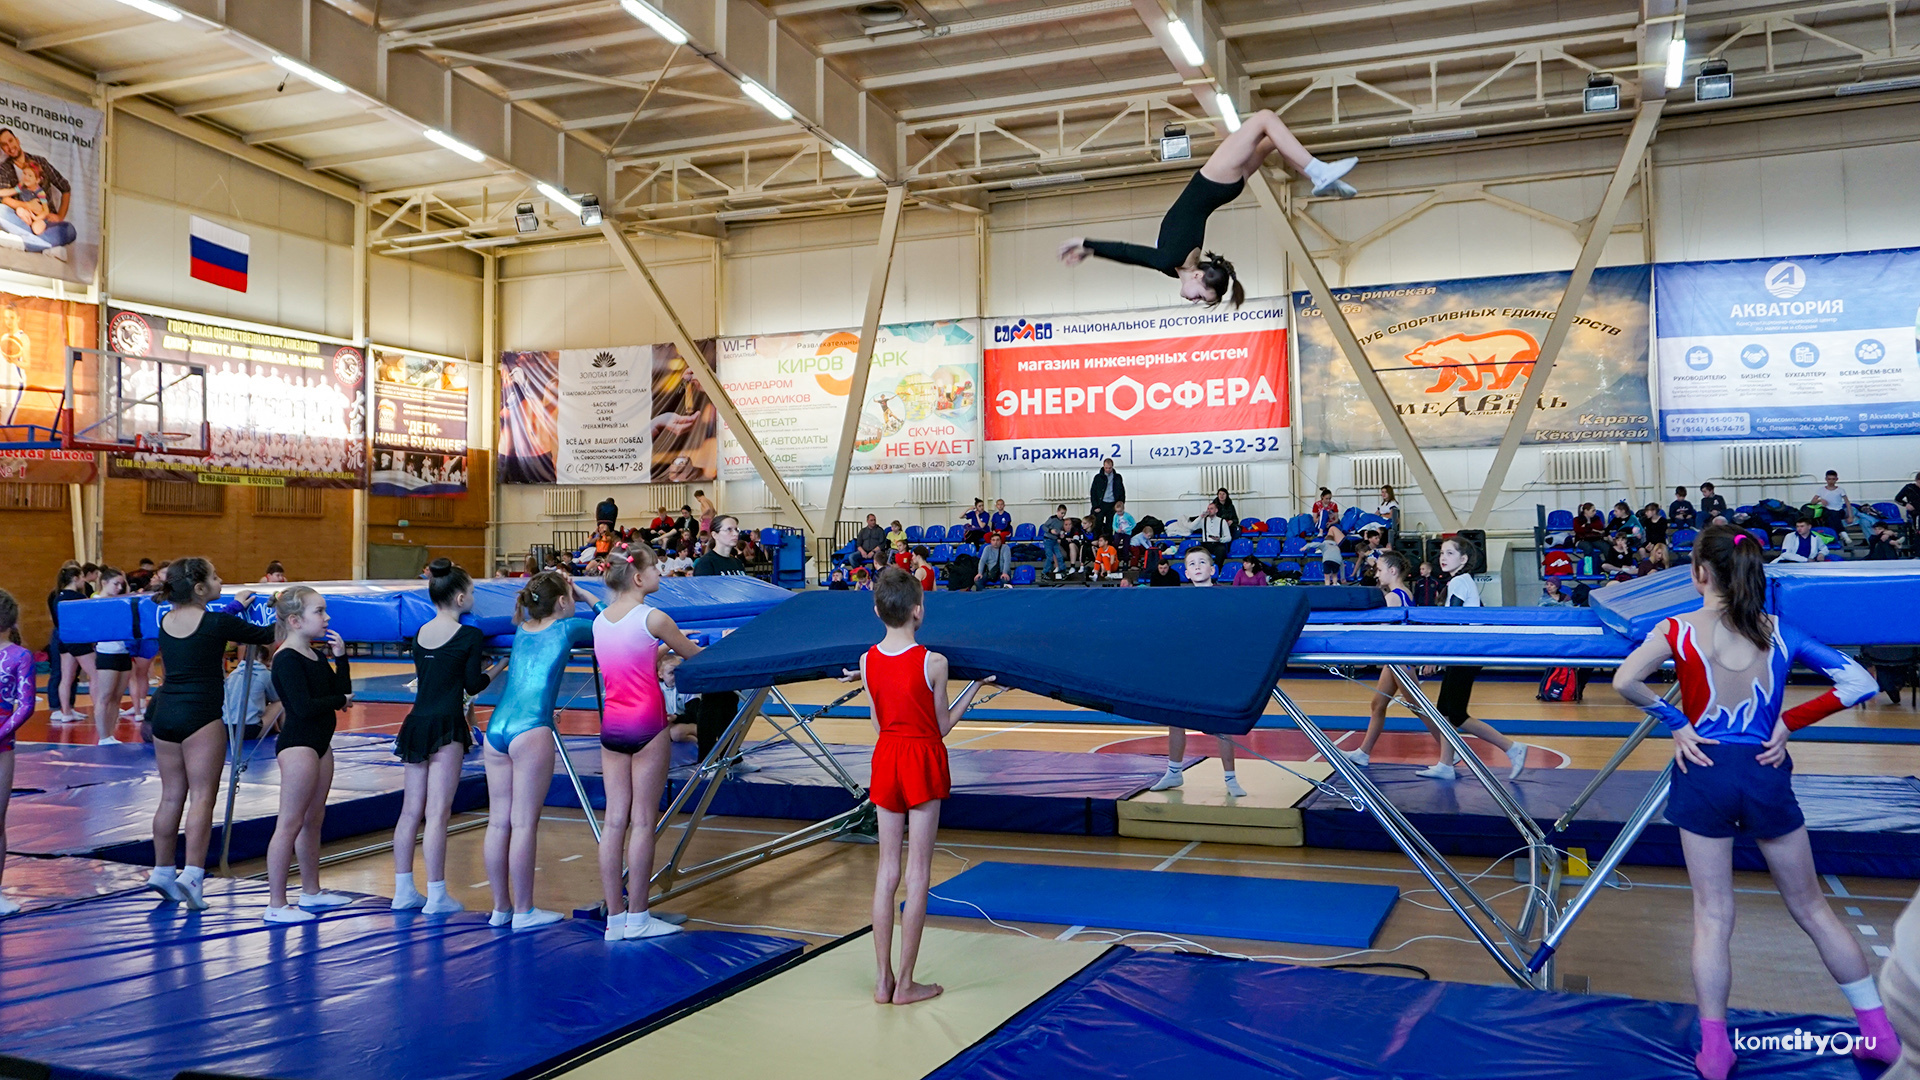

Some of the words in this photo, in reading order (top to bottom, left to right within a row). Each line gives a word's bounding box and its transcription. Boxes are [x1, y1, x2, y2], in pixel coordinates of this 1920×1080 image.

[12, 99, 28, 113] на
[30, 104, 84, 128] главное
[71, 135, 95, 149] мы!
[1729, 299, 1844, 318] АКВАТОРИЯ
[1063, 318, 1156, 335] НАЦИОНАЛЬНОЕ
[1159, 312, 1229, 330] ДОСТОЯНИЕ
[1233, 308, 1284, 322] РОССИИ!
[1357, 330, 1384, 346] ЛУБ
[1387, 308, 1497, 336] СПОРТИВНЫХ
[167, 319, 213, 338] ГОРОДСКАЯ
[213, 326, 271, 347] ОБЩЕСТВЕННАЯ
[271, 337, 320, 354] ОРГАНИЗАЦИЯ
[723, 338, 757, 352] WI-FI
[777, 355, 844, 374] КИРОВ
[870, 350, 909, 368] АРК
[1017, 358, 1081, 372] магазин
[1084, 352, 1188, 369] инженерных
[1191, 347, 1249, 362] систем
[579, 371, 608, 380] ЗОЛОТАЯ
[608, 369, 629, 378] ЛИЛИЯ
[1673, 374, 1728, 382] РУКОВОДИТЕЛЮ
[1740, 372, 1771, 380] БИЗНЕСУ
[1785, 371, 1827, 379] БУХГАЛТЕРУ
[1839, 368, 1903, 377] ВСЕМ-ВСЕМ-ВСЕМ
[723, 379, 793, 392] РОЛЛЕРДРОМ
[732, 396, 760, 406] КОЛА
[761, 394, 811, 405] РОЛИКОВ
[995, 375, 1278, 421] ЭНЕРГОСФЕРА
[746, 417, 798, 428] ИНОТЕАТР
[1579, 414, 1649, 428] Каратэ
[908, 425, 955, 437] СКУЧНО
[1534, 427, 1649, 442] Кёкусинкай
[374, 431, 410, 446] НАШЕ
[578, 438, 592, 446] ДЛЯ
[594, 437, 618, 445] ВАШИХ
[770, 435, 829, 446] АВТОМАТЫ
[886, 442, 910, 457] НЕ
[914, 439, 975, 456] БУДЕТ
[1111, 443, 1122, 458] 2
[50, 450, 95, 461] школа
[768, 453, 798, 464] КАФЕ
[575, 463, 604, 474] (4217)
[604, 462, 644, 473] 54-17-28
[881, 463, 889, 471] (3
[888, 462, 907, 471] этаж)
[946, 459, 976, 468] 30-07-07
